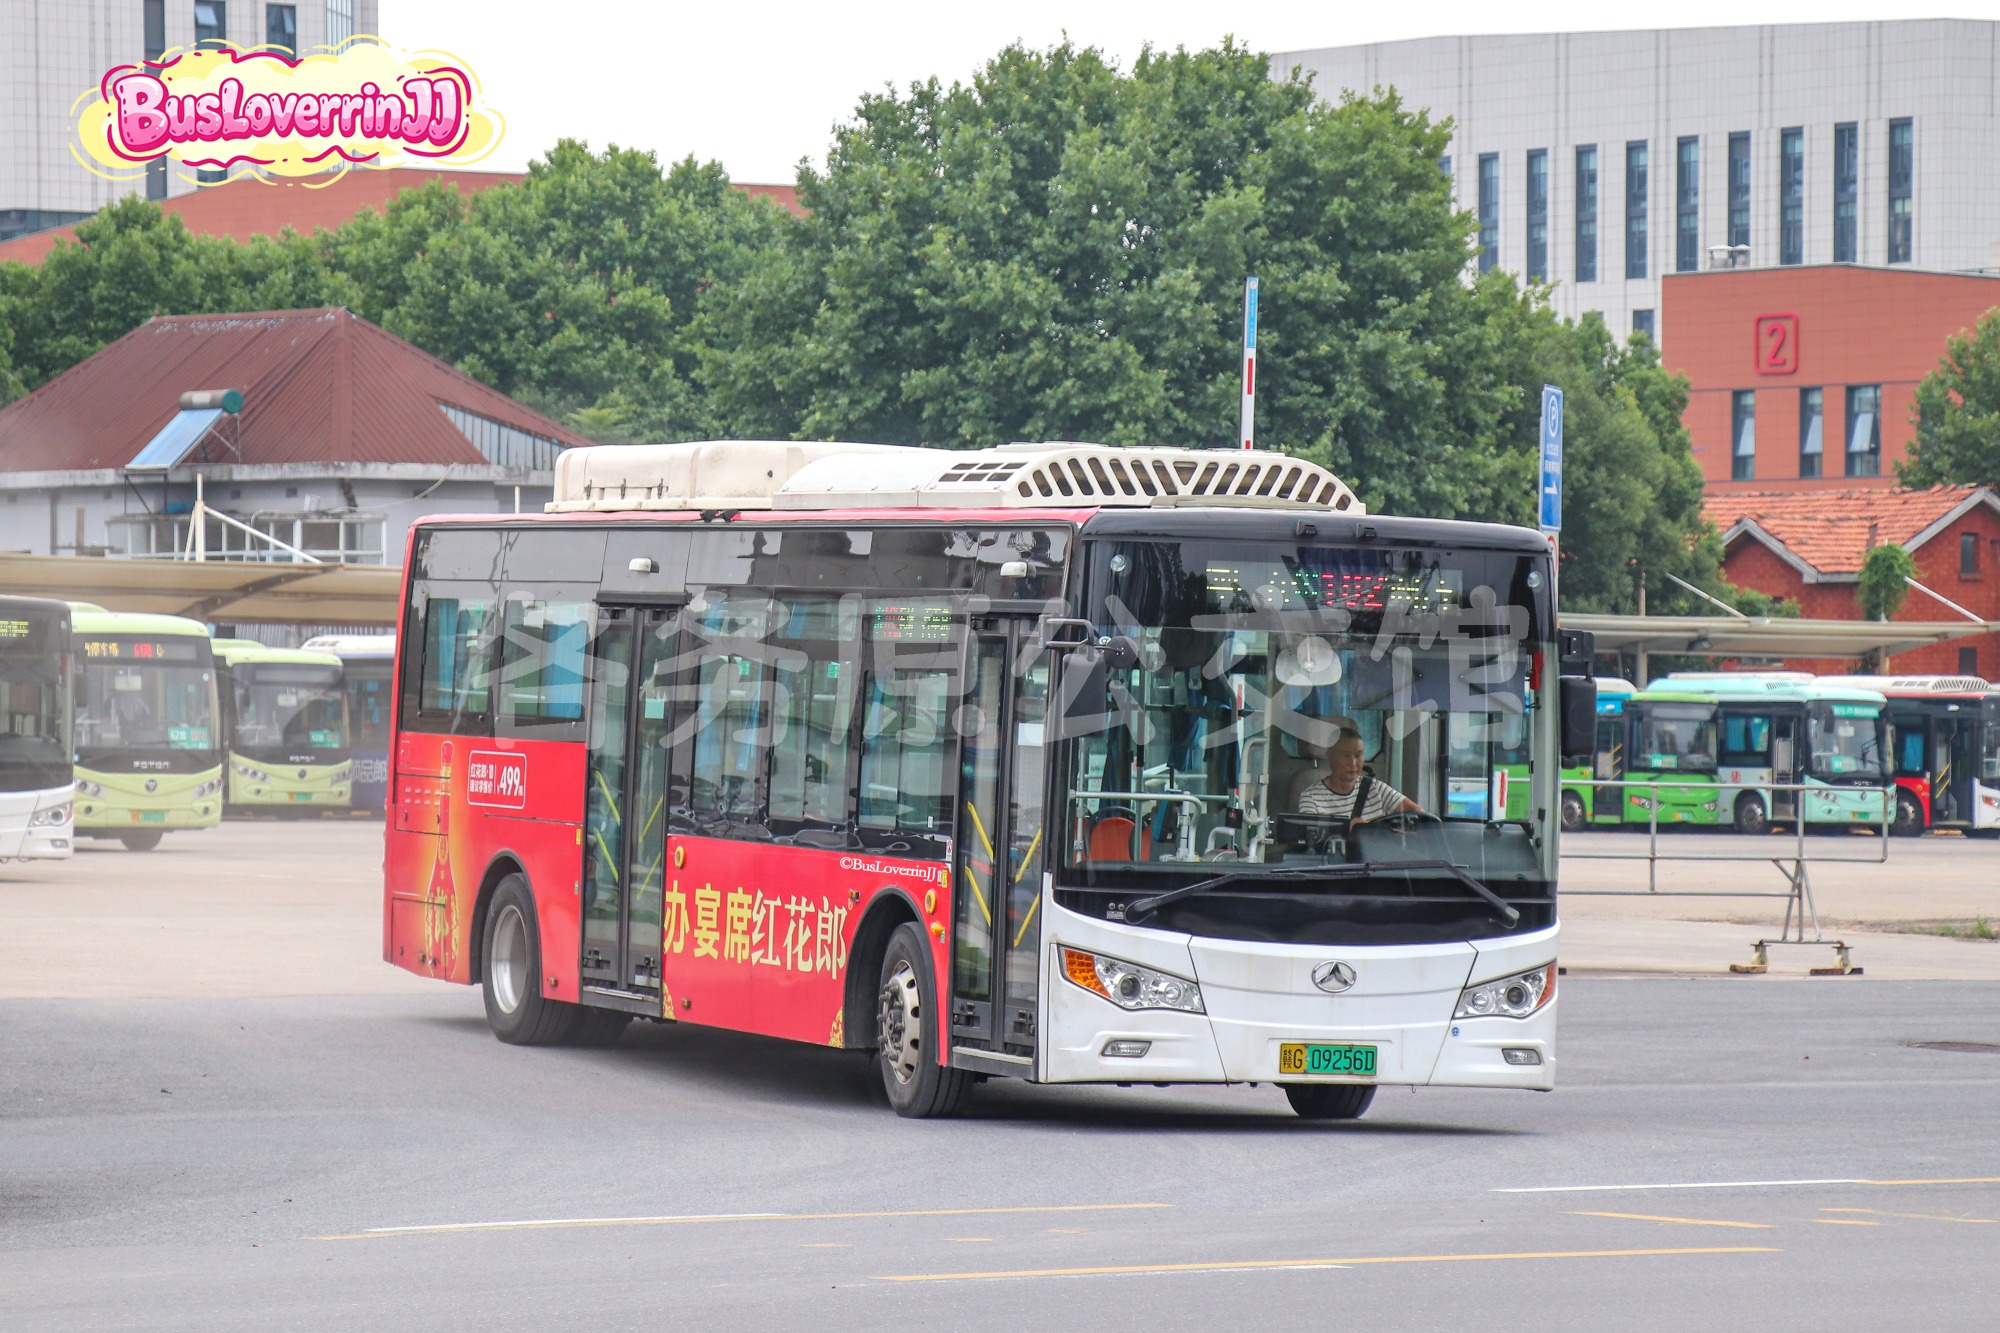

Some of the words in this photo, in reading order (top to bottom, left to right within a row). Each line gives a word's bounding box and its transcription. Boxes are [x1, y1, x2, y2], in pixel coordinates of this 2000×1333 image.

[1766, 322, 1786, 366] 2
[663, 879, 848, 980] 办宴席红花郎
[1311, 1048, 1375, 1071] 09256D
